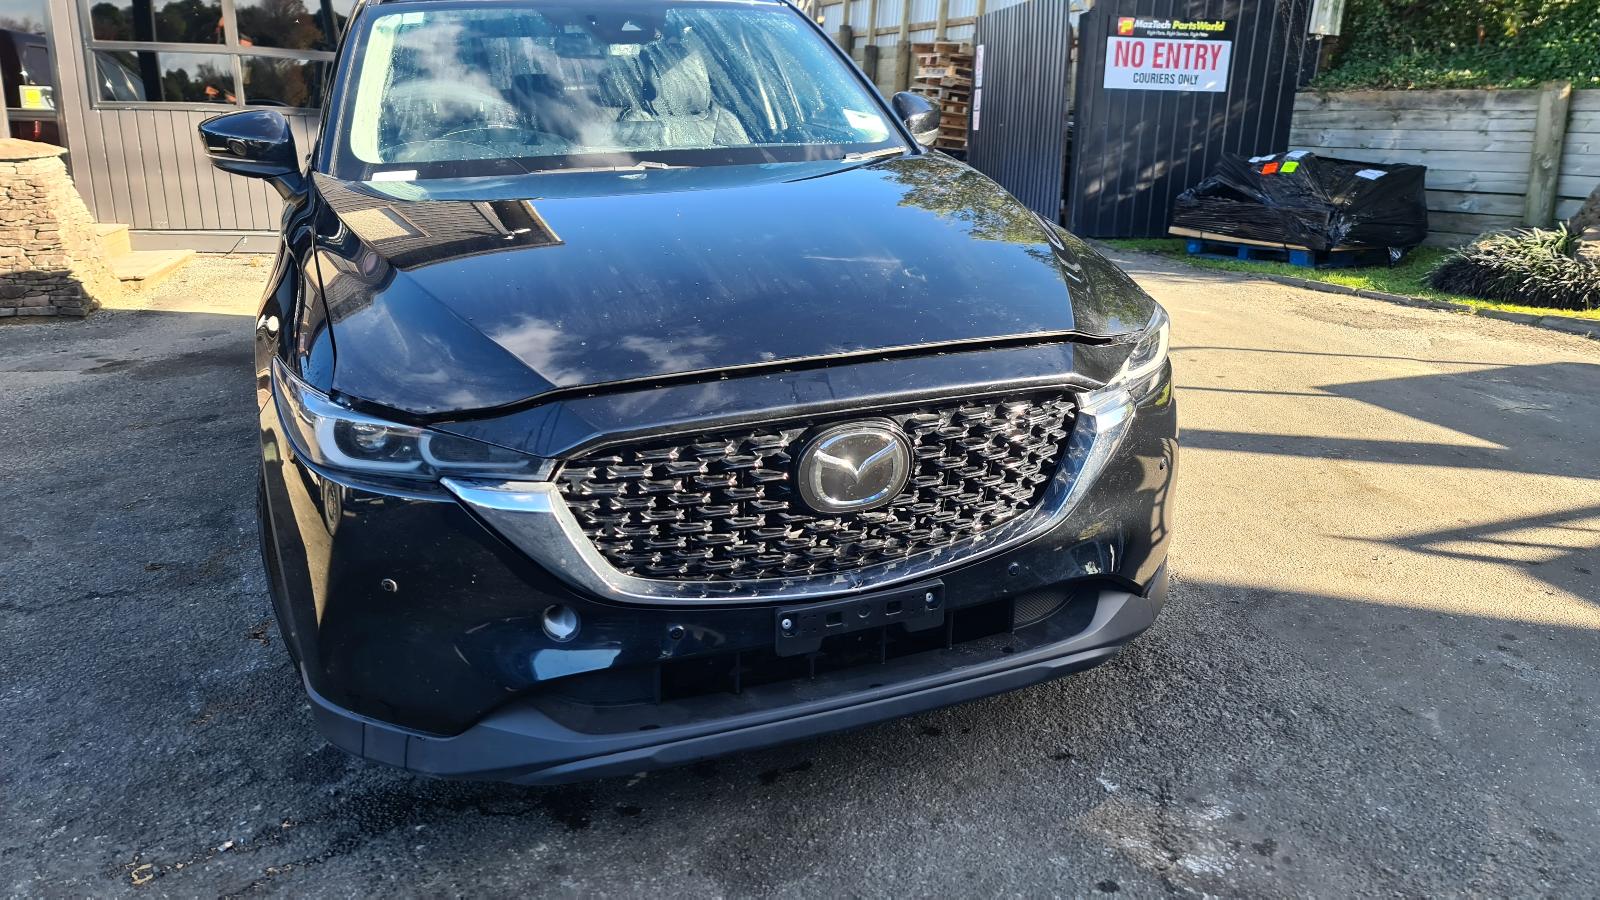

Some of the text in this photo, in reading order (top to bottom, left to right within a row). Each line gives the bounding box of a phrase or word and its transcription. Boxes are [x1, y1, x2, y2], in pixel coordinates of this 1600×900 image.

[1172, 20, 1226, 31] PartsWorld
[1114, 40, 1223, 71] NO ENTRY
[1133, 72, 1199, 85] COURIERS ONLY
